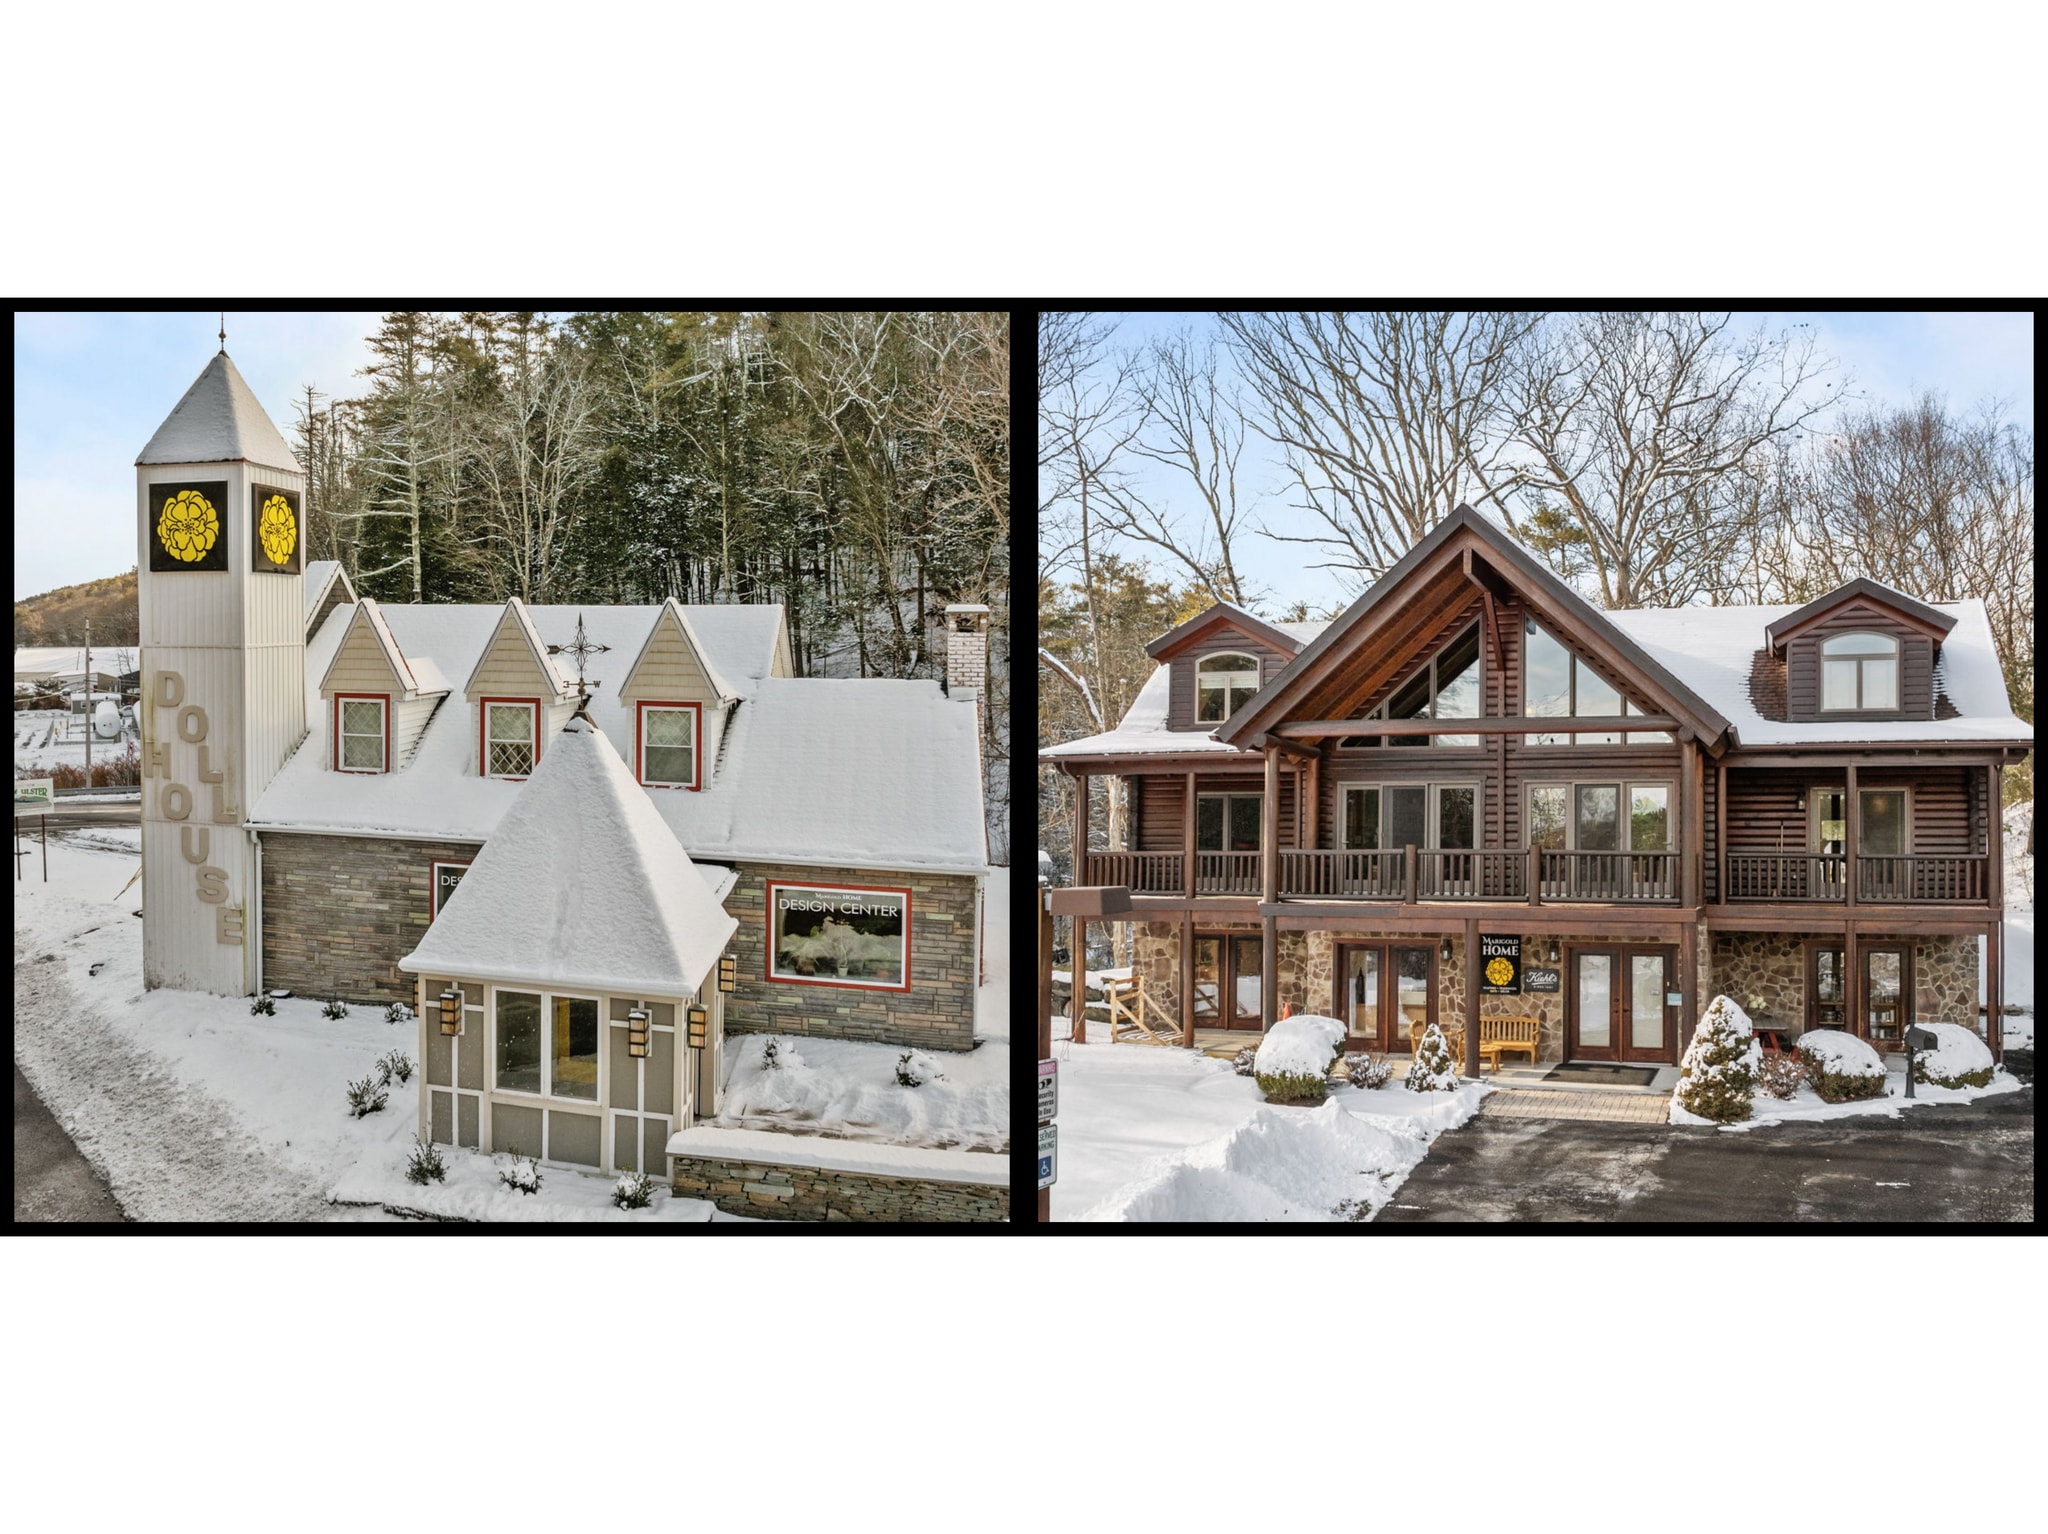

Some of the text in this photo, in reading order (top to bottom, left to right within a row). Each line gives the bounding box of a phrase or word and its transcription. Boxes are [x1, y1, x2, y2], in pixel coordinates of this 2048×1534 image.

[156, 670, 237, 824] DOLL
[21, 788, 47, 796] ULSTER
[144, 741, 243, 945] HOUSE
[779, 898, 898, 917] DESIGN CENTER
[1482, 945, 1519, 956] HOME
[1039, 1130, 1056, 1141] SERVED
